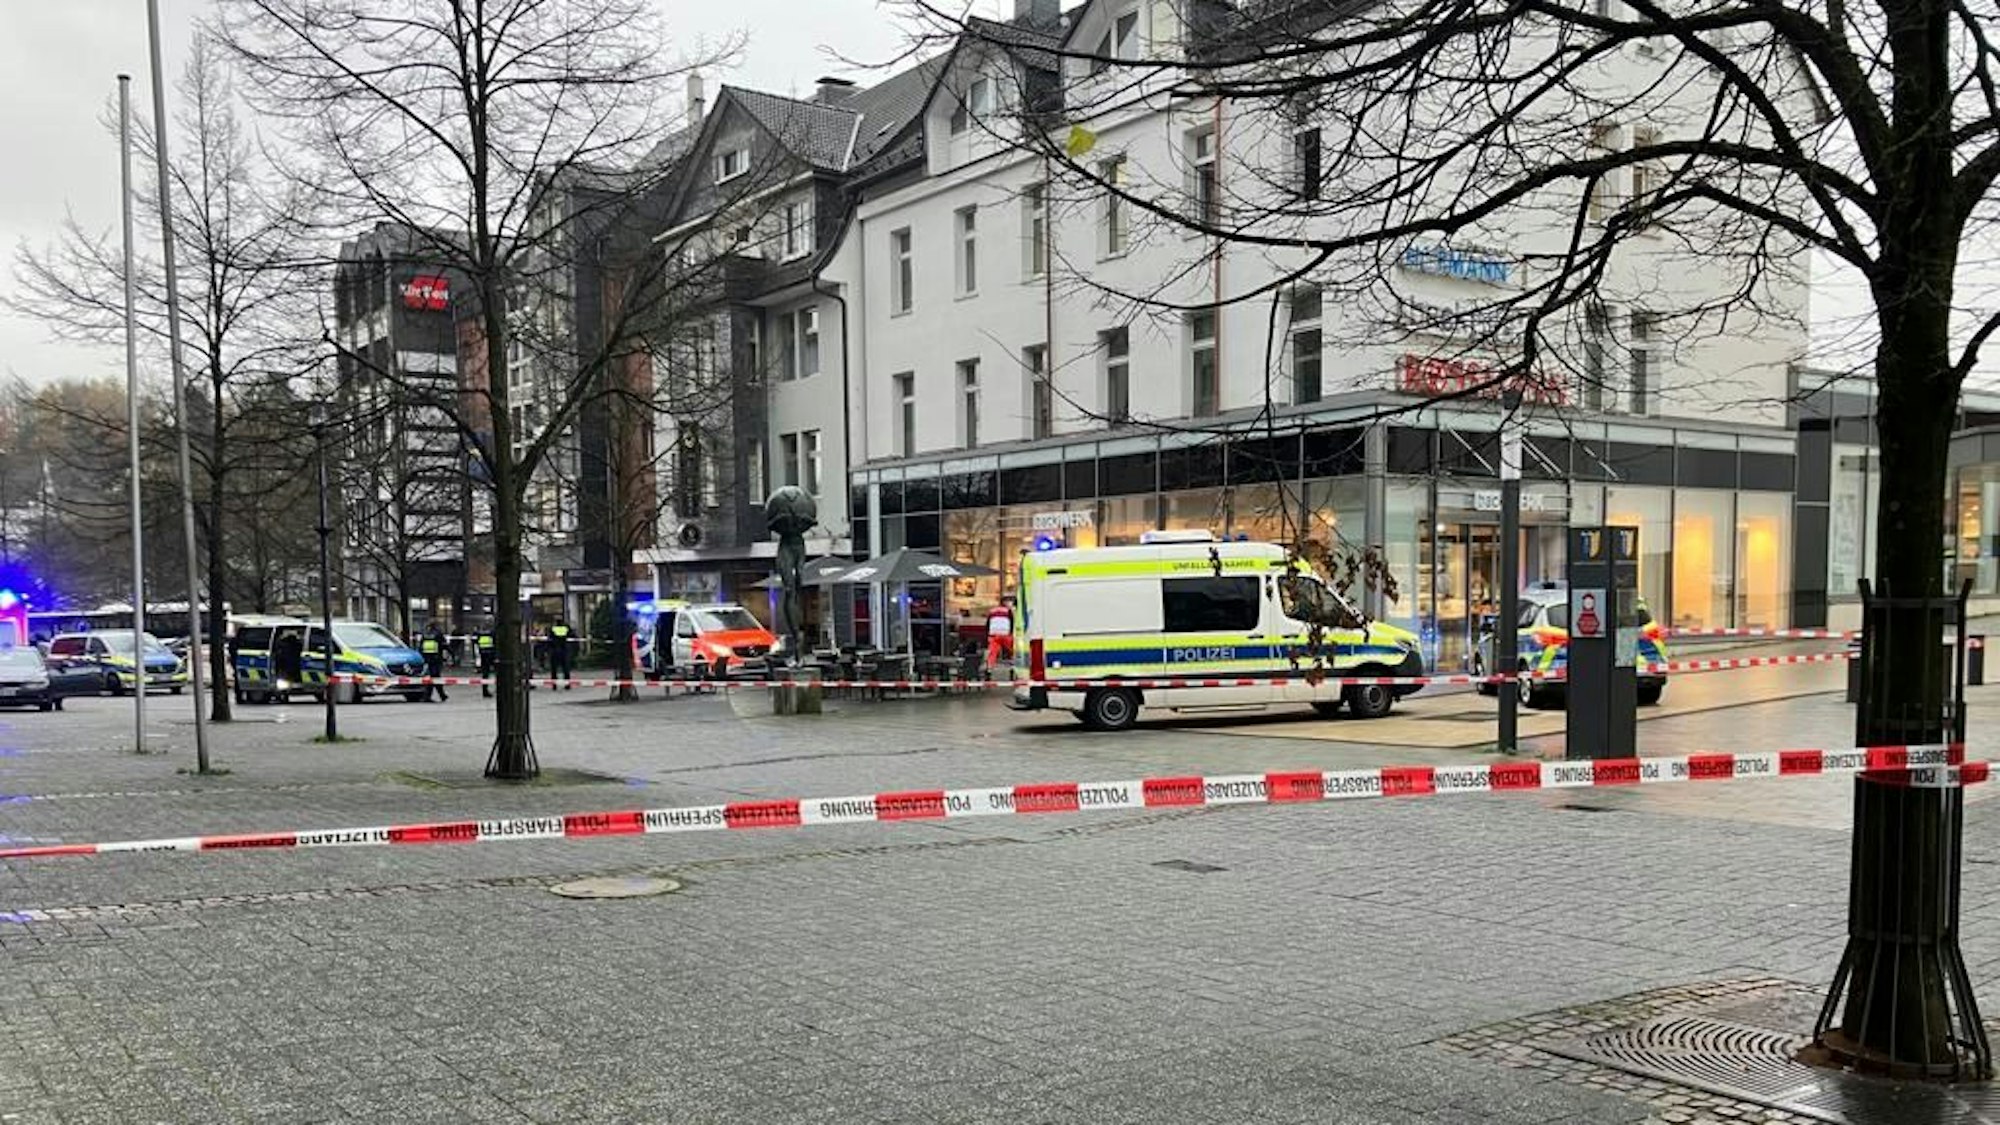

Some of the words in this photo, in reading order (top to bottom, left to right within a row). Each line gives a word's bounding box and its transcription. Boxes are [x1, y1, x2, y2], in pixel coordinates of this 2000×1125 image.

[1174, 647, 1236, 662] POLIZEI
[1554, 764, 1659, 782] POLIZEIABSPERRUNG
[1291, 775, 1412, 795] POLIZEIABSPERRUNG
[820, 797, 971, 818] POLIZEIABSPERRUNG
[989, 788, 1128, 808] POLIZEIABSPERRUNG
